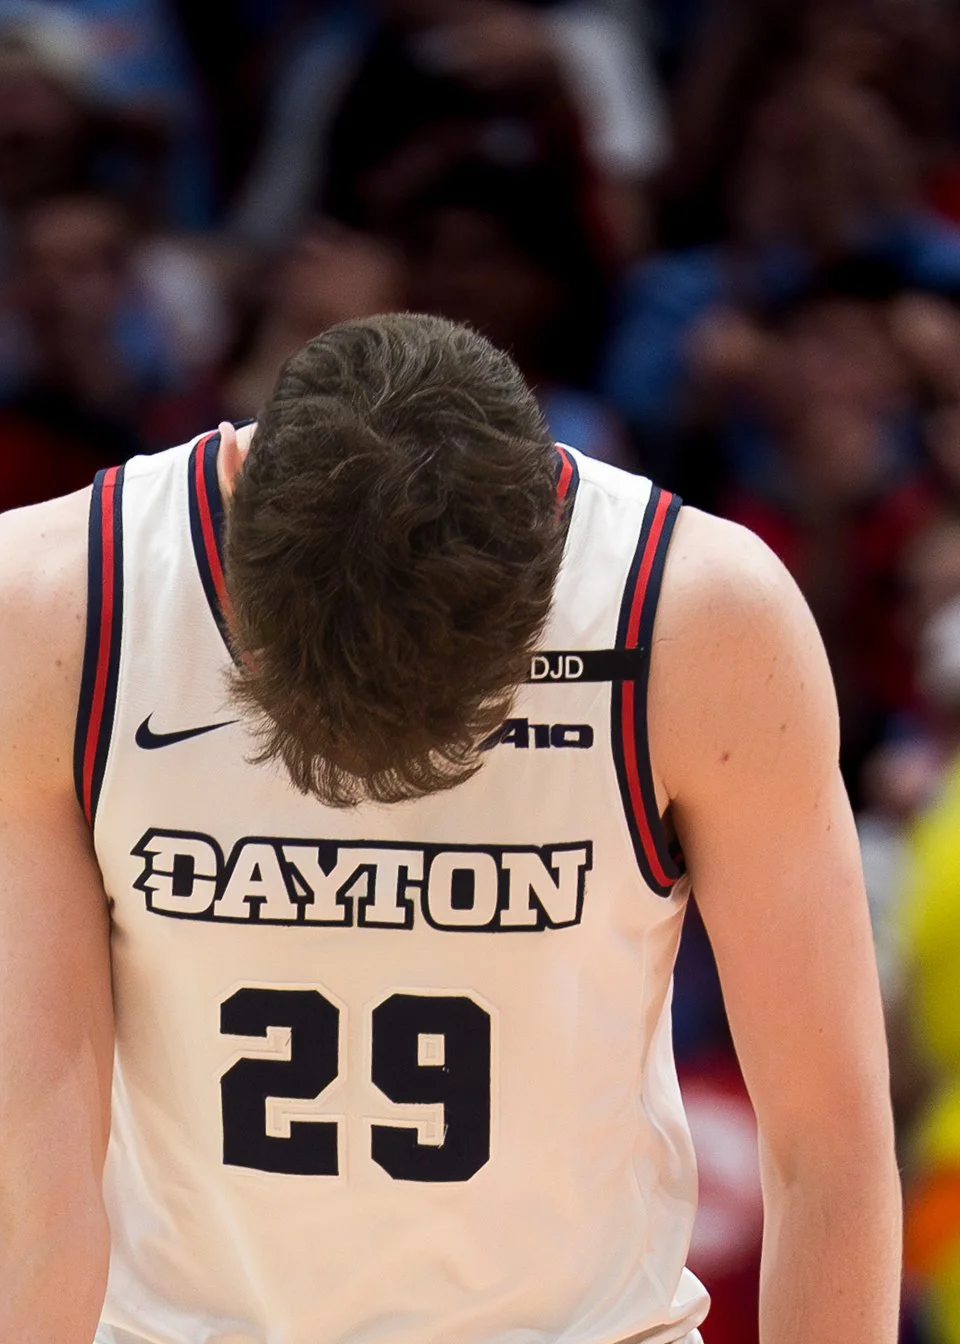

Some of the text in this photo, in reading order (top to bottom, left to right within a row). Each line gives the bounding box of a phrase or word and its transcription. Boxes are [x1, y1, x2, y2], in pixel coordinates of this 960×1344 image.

[530, 655, 584, 680] DJD
[485, 717, 594, 749] A10
[130, 827, 594, 933] DAYTON
[219, 987, 491, 1183] 29
